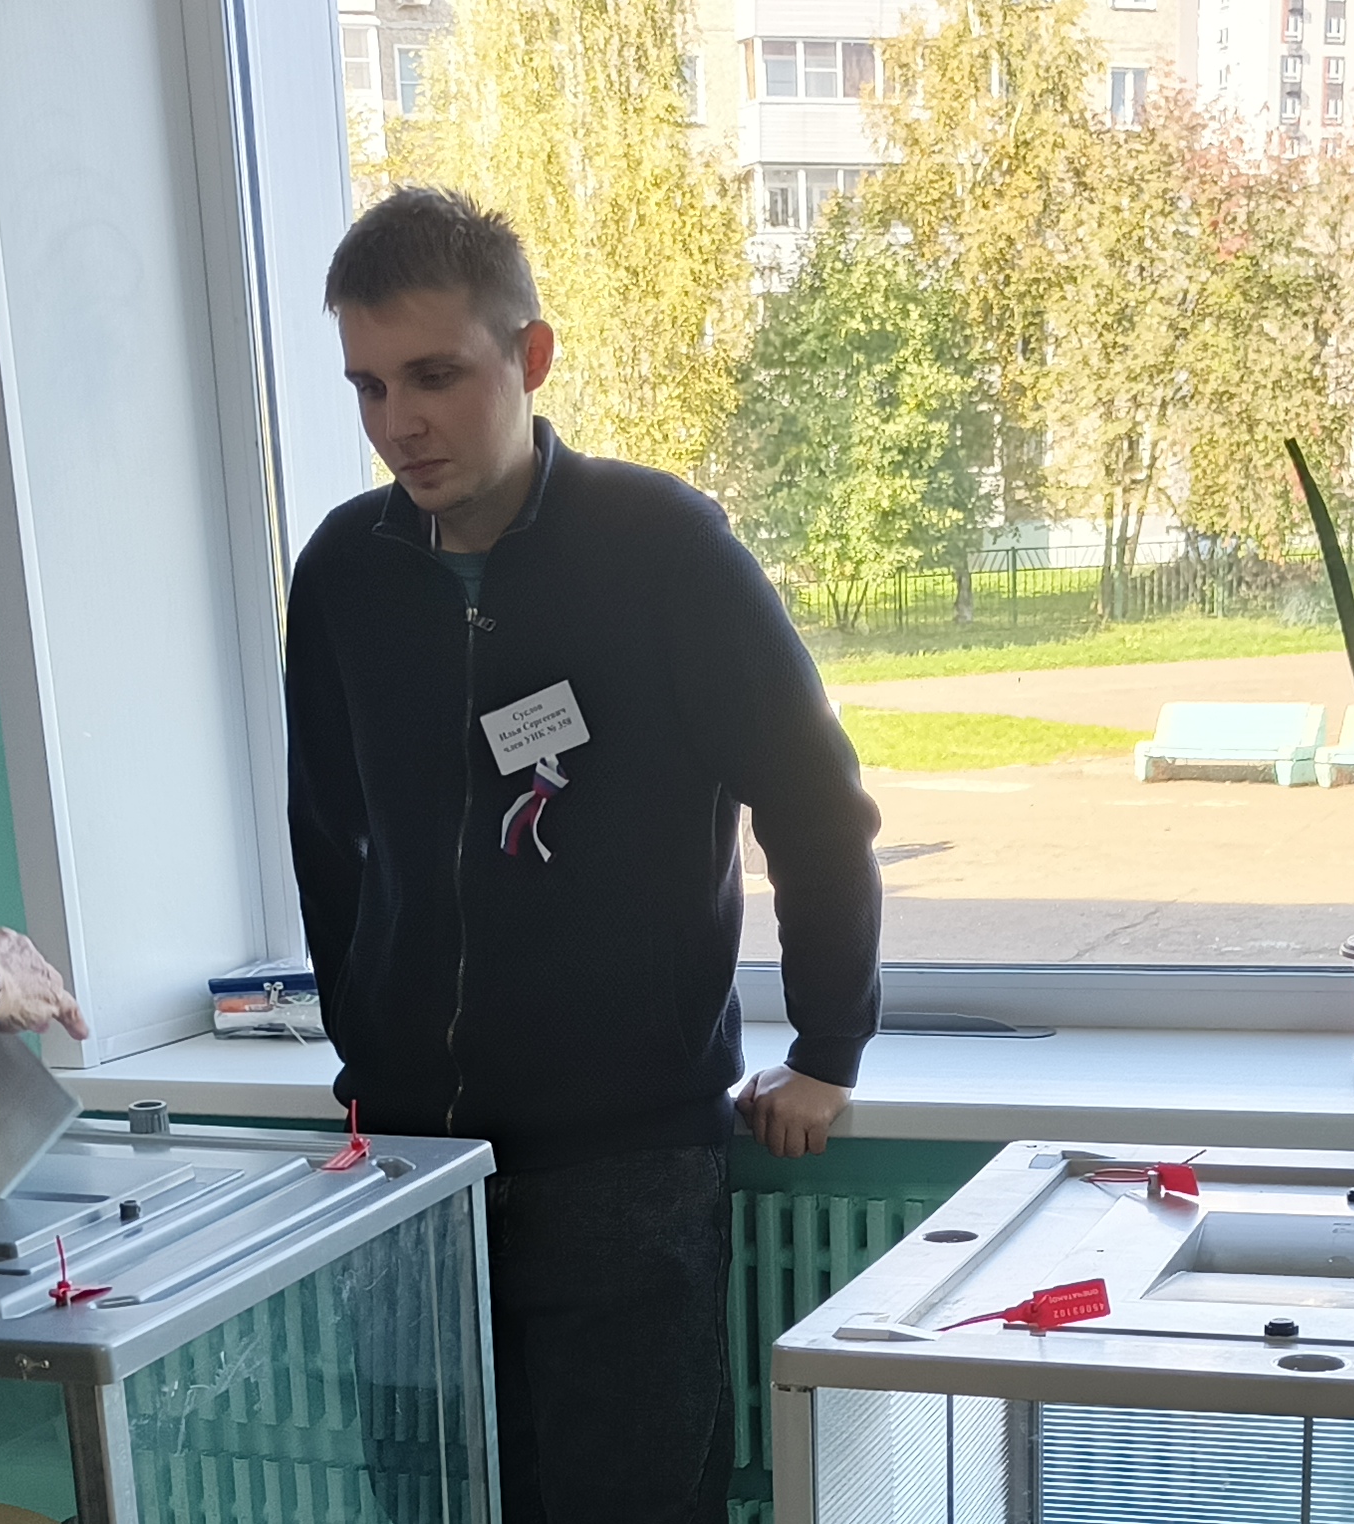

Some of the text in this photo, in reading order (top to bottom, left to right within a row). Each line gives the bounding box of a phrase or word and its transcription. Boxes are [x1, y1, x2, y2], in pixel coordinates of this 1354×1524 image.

[512, 704, 543, 721] Суслов
[499, 708, 566, 741] Илья Сергеевич
[524, 728, 546, 744] УИК
